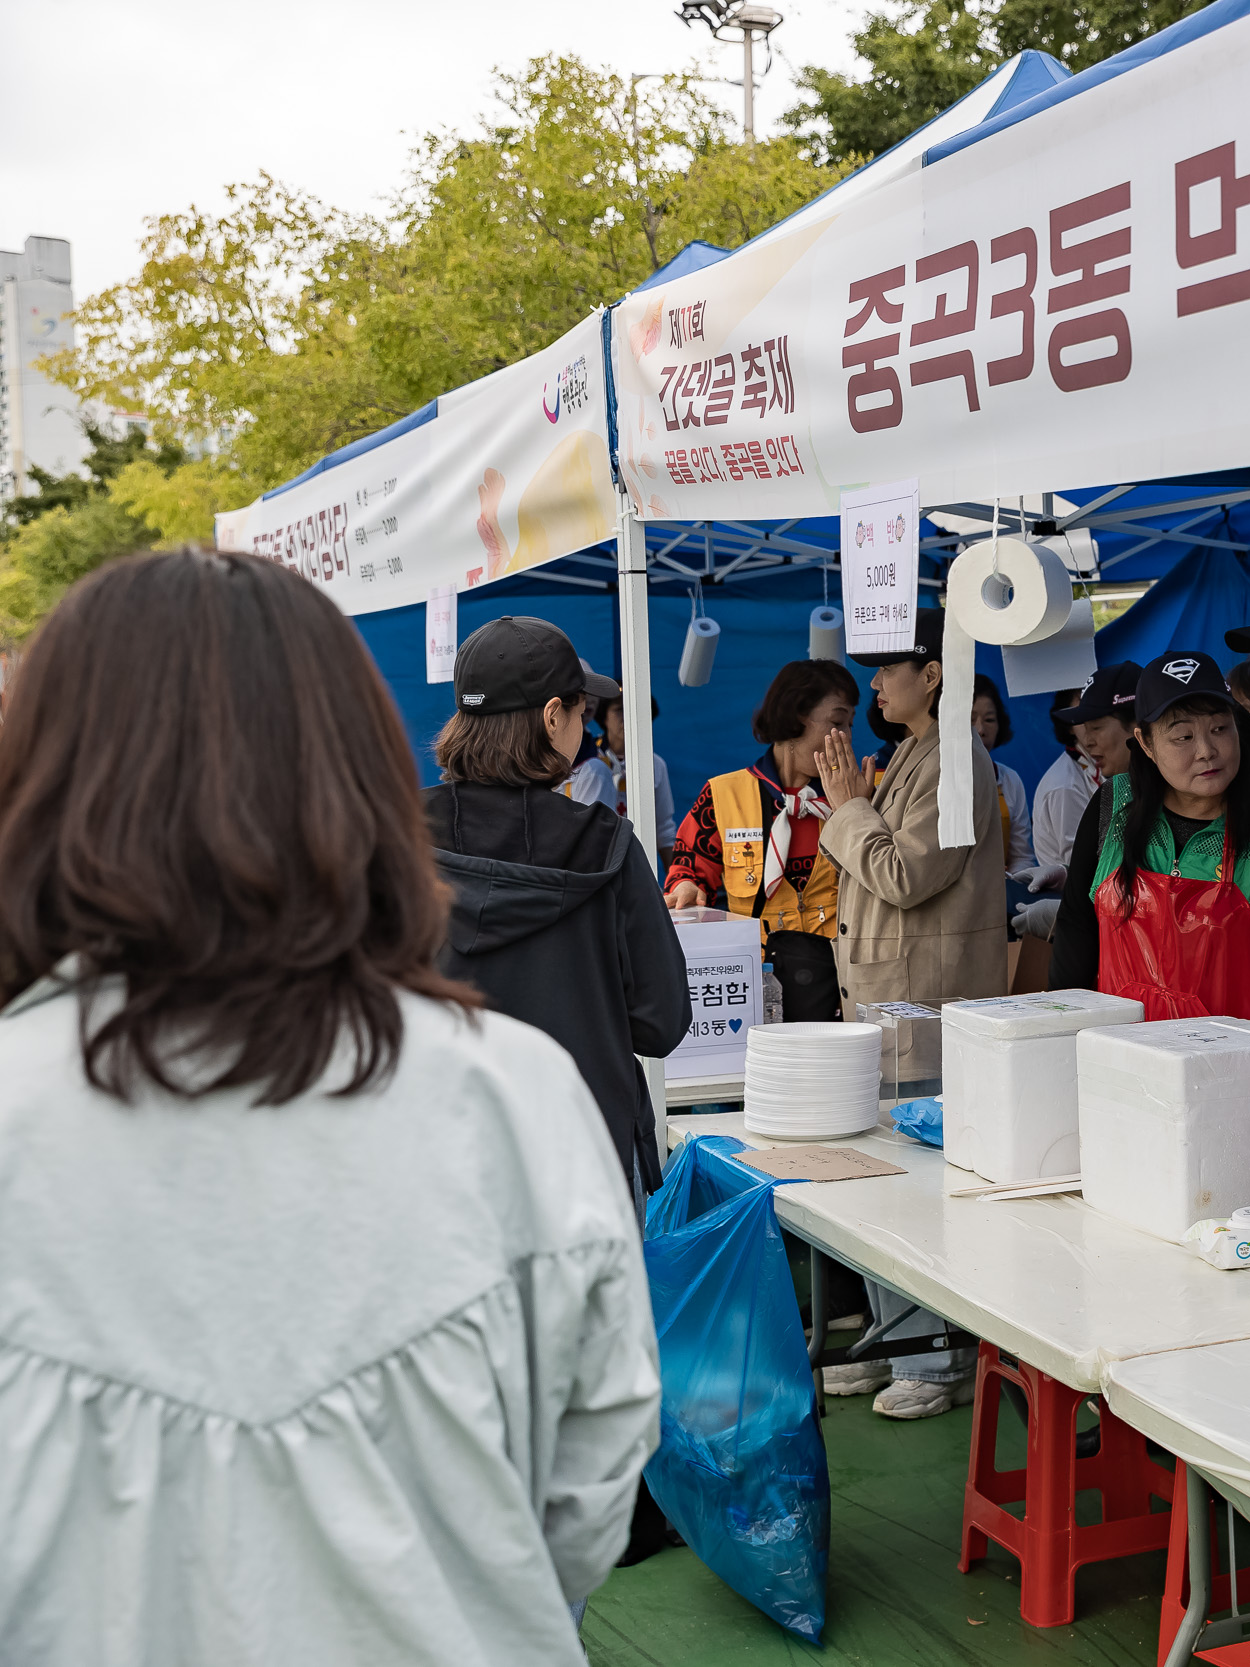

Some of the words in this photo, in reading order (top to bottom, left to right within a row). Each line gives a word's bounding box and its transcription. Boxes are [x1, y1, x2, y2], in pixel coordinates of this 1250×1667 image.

[669, 300, 707, 349] 제11회
[841, 179, 1132, 434] 중곡3동
[740, 335, 795, 418] 축제
[665, 449, 697, 485] 꿈을
[720, 440, 772, 481] 중곡을
[766, 435, 804, 477] 잇다
[866, 562, 896, 590] 5,000원
[855, 605, 877, 624] 쿠폰으로
[879, 604, 890, 622] 구매
[892, 603, 908, 622] 하세요
